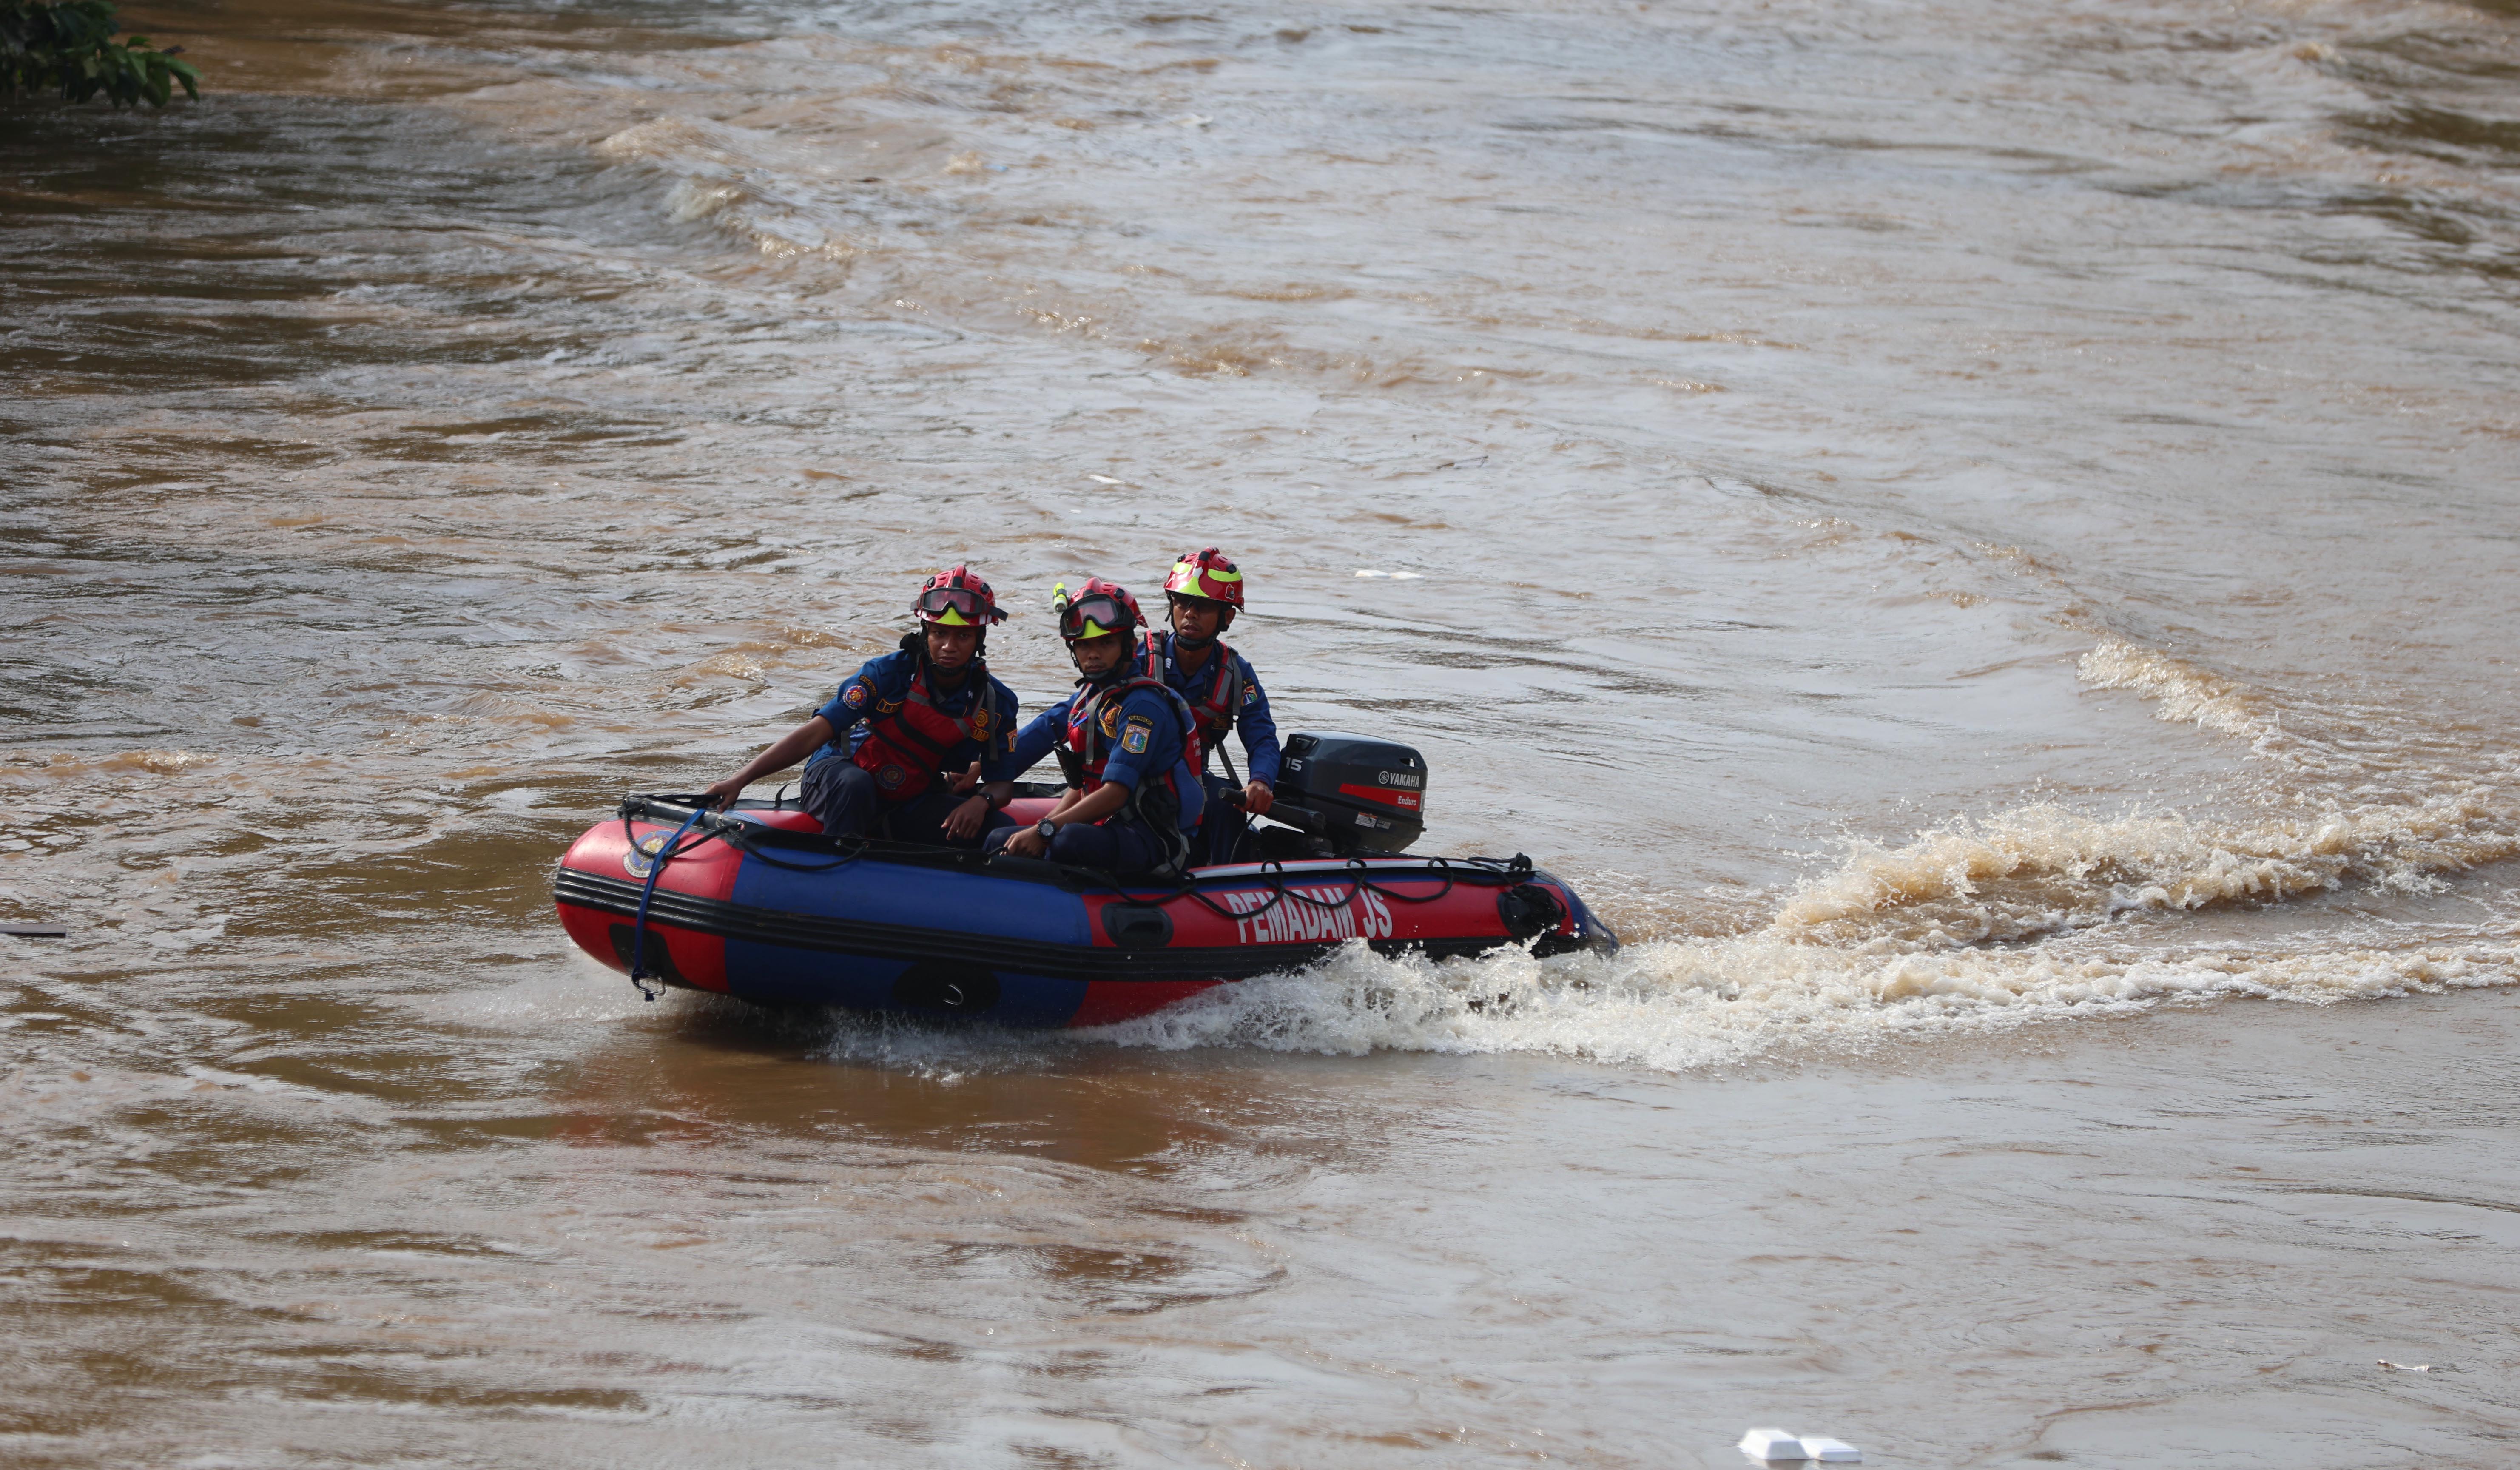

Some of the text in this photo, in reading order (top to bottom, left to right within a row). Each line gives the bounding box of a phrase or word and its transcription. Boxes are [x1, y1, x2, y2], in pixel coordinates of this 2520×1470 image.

[1286, 757, 1303, 771] 15
[1390, 773, 1419, 788] YAMAHA
[1398, 796, 1417, 806] Enduro
[1223, 887, 1393, 943] PEMADAM JS
